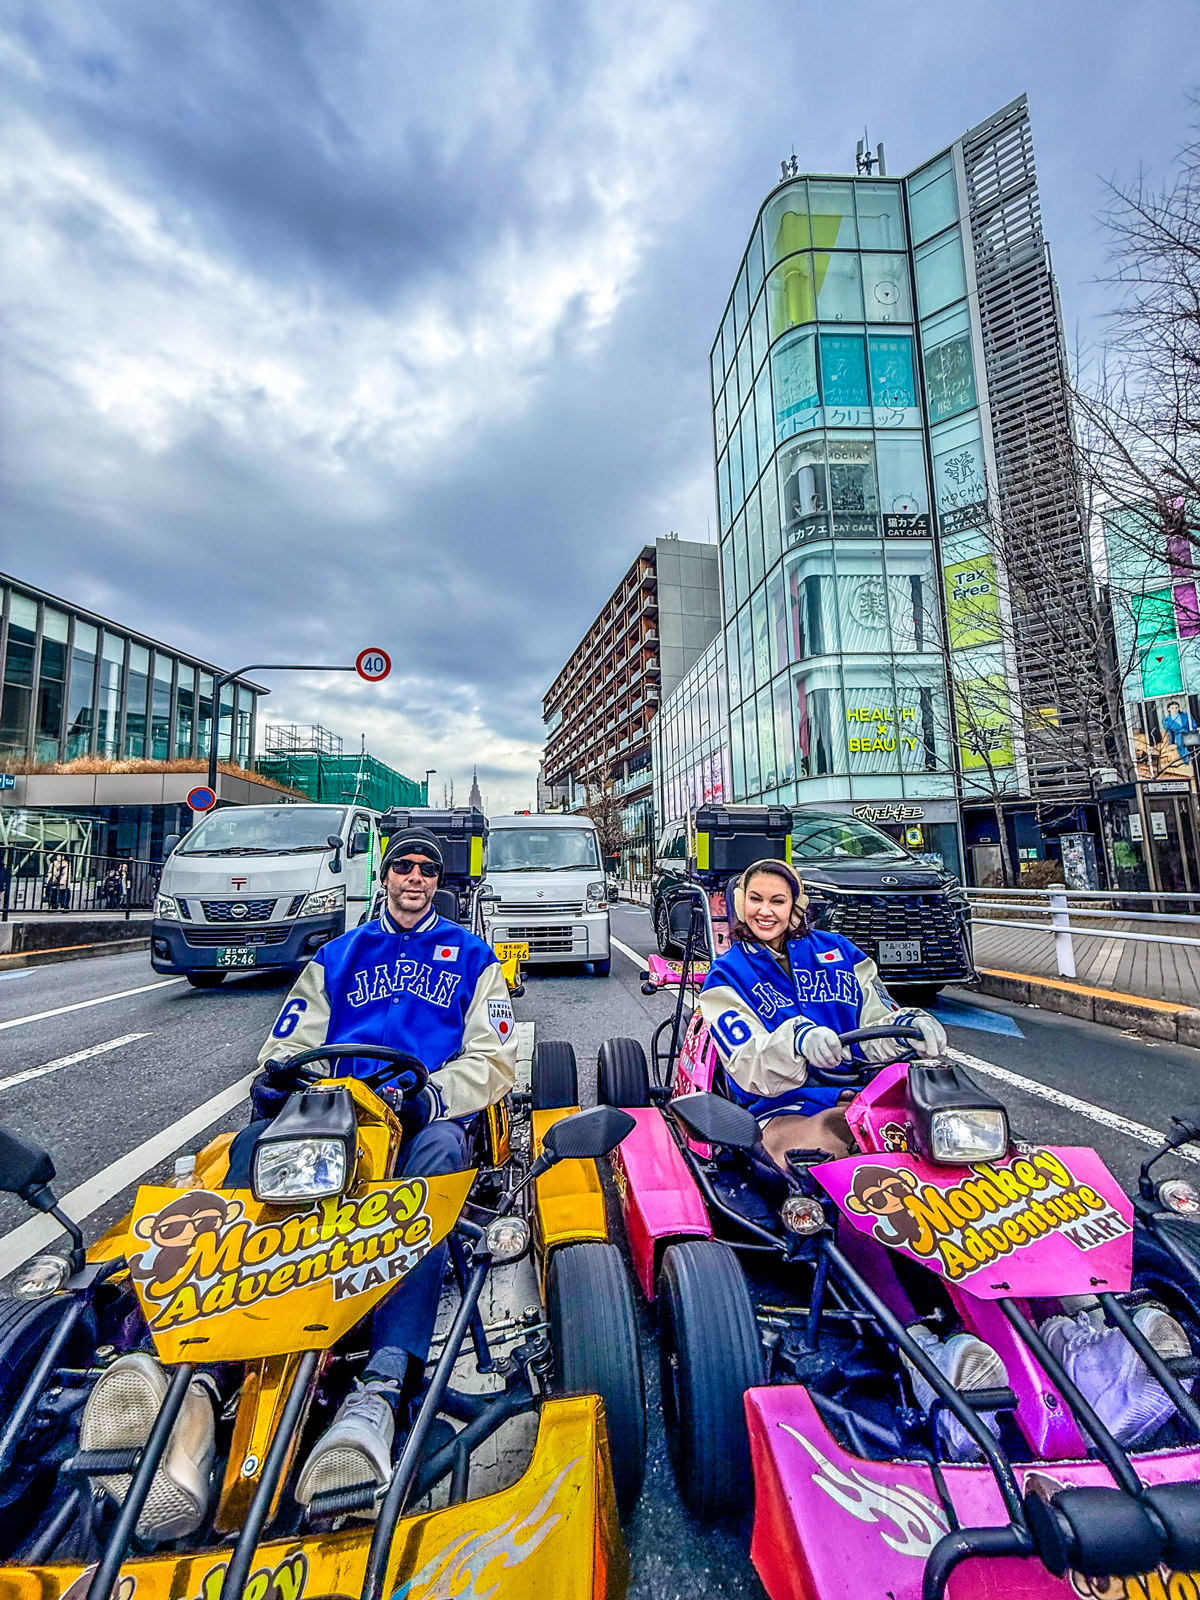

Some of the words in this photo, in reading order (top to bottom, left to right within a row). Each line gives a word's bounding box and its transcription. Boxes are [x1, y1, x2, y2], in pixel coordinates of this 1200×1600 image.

[941, 483, 984, 504] MOCHA
[833, 524, 850, 533] CAT
[852, 523, 875, 532] CAFE
[887, 517, 927, 529] 猫カフェ
[887, 529, 906, 537] CAT
[907, 529, 928, 537] CAFE
[945, 523, 962, 533] CAT
[954, 569, 985, 585] Tax
[952, 583, 990, 601] Free
[364, 656, 384, 672] 40
[847, 707, 915, 722] HEALH
[853, 803, 925, 822] マツモトキヨシ
[347, 959, 462, 1009] JAPAN
[752, 968, 859, 1019] JAPAN
[488, 1003, 512, 1011] SAMURA
[491, 1009, 514, 1020] JAPAN
[272, 997, 307, 1039] 6
[709, 1009, 752, 1060] 16
[905, 1149, 1075, 1254] Monkey
[149, 1178, 428, 1298] Monkey
[937, 1183, 1107, 1279] Adventure
[1062, 1210, 1129, 1251] KART
[150, 1215, 432, 1333] Adventure
[333, 1243, 432, 1301] KART
